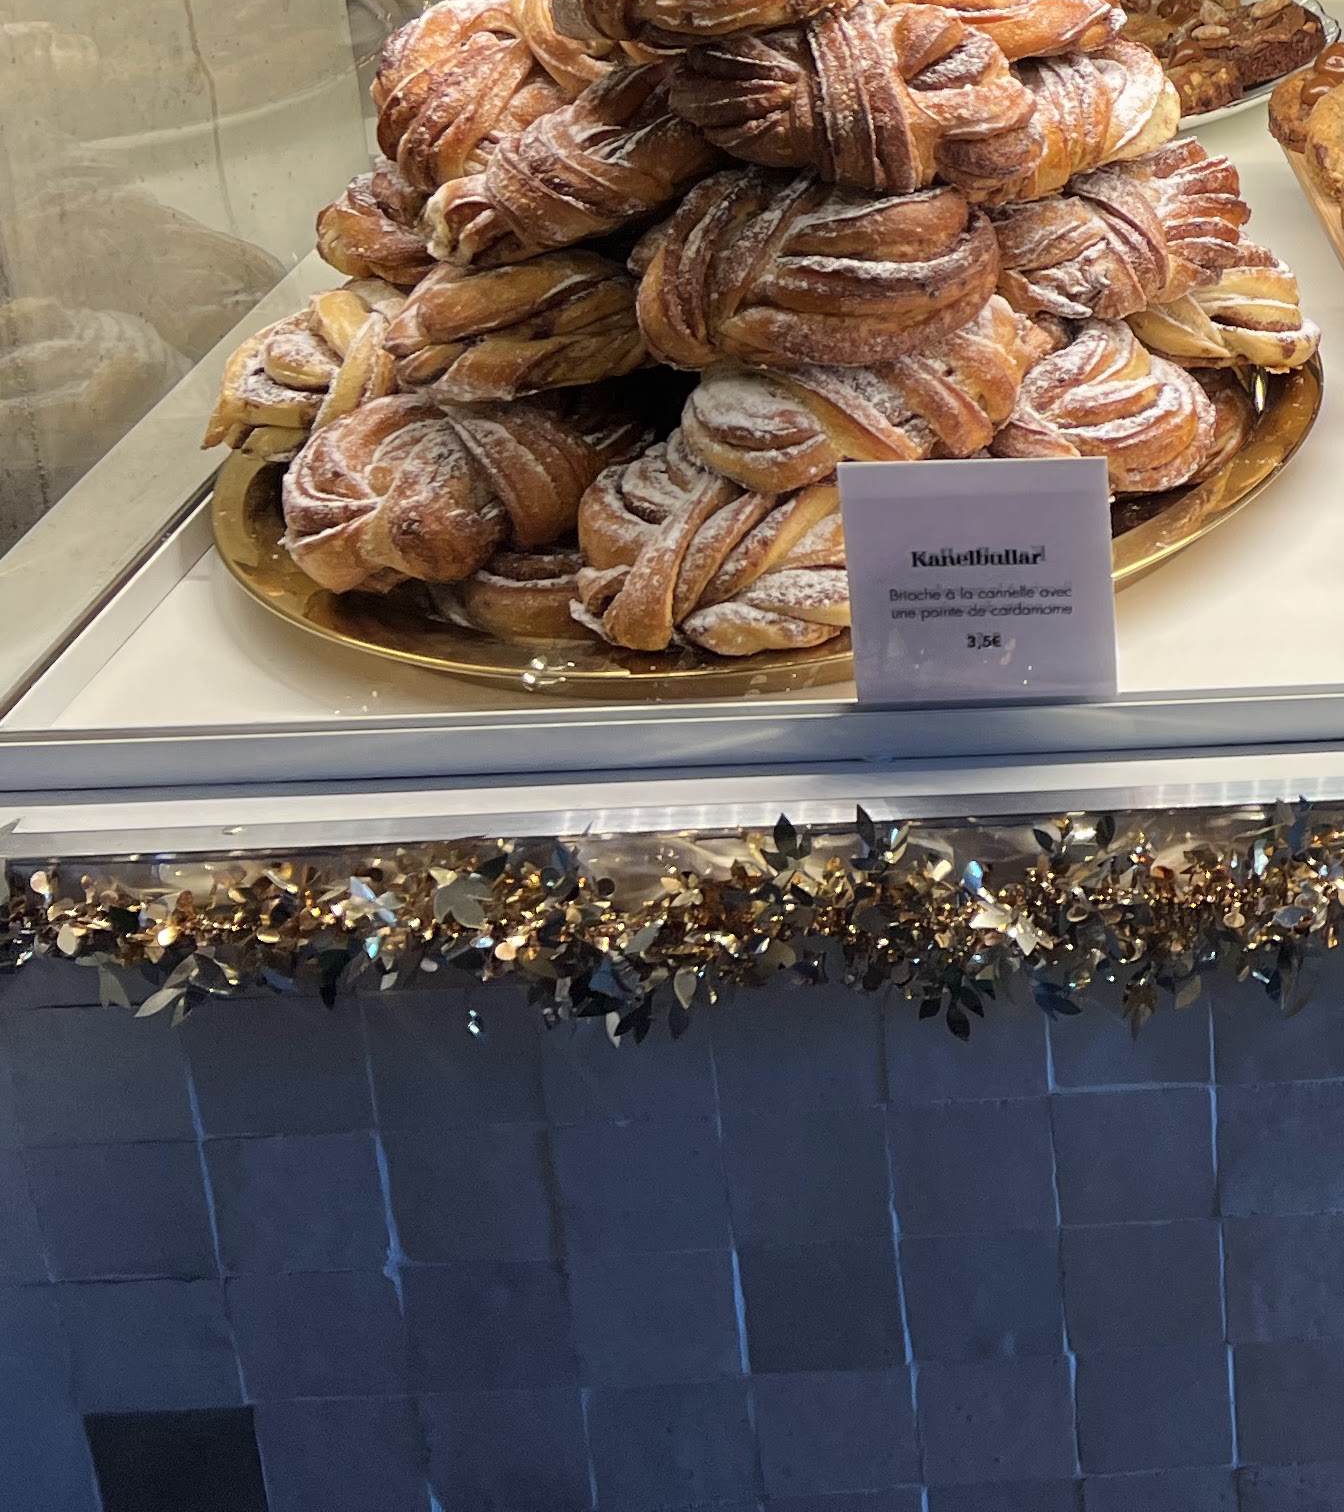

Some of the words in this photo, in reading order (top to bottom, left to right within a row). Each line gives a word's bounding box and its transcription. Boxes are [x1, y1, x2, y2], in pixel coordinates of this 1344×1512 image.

[890, 588, 940, 602] Brioche
[946, 587, 956, 600] à
[960, 586, 973, 599] la
[978, 584, 1035, 599] cannelle
[1040, 586, 1072, 598] avec
[891, 608, 915, 619] une
[921, 605, 963, 622] pointe
[968, 604, 986, 617] de
[990, 603, 1072, 617] cardamome
